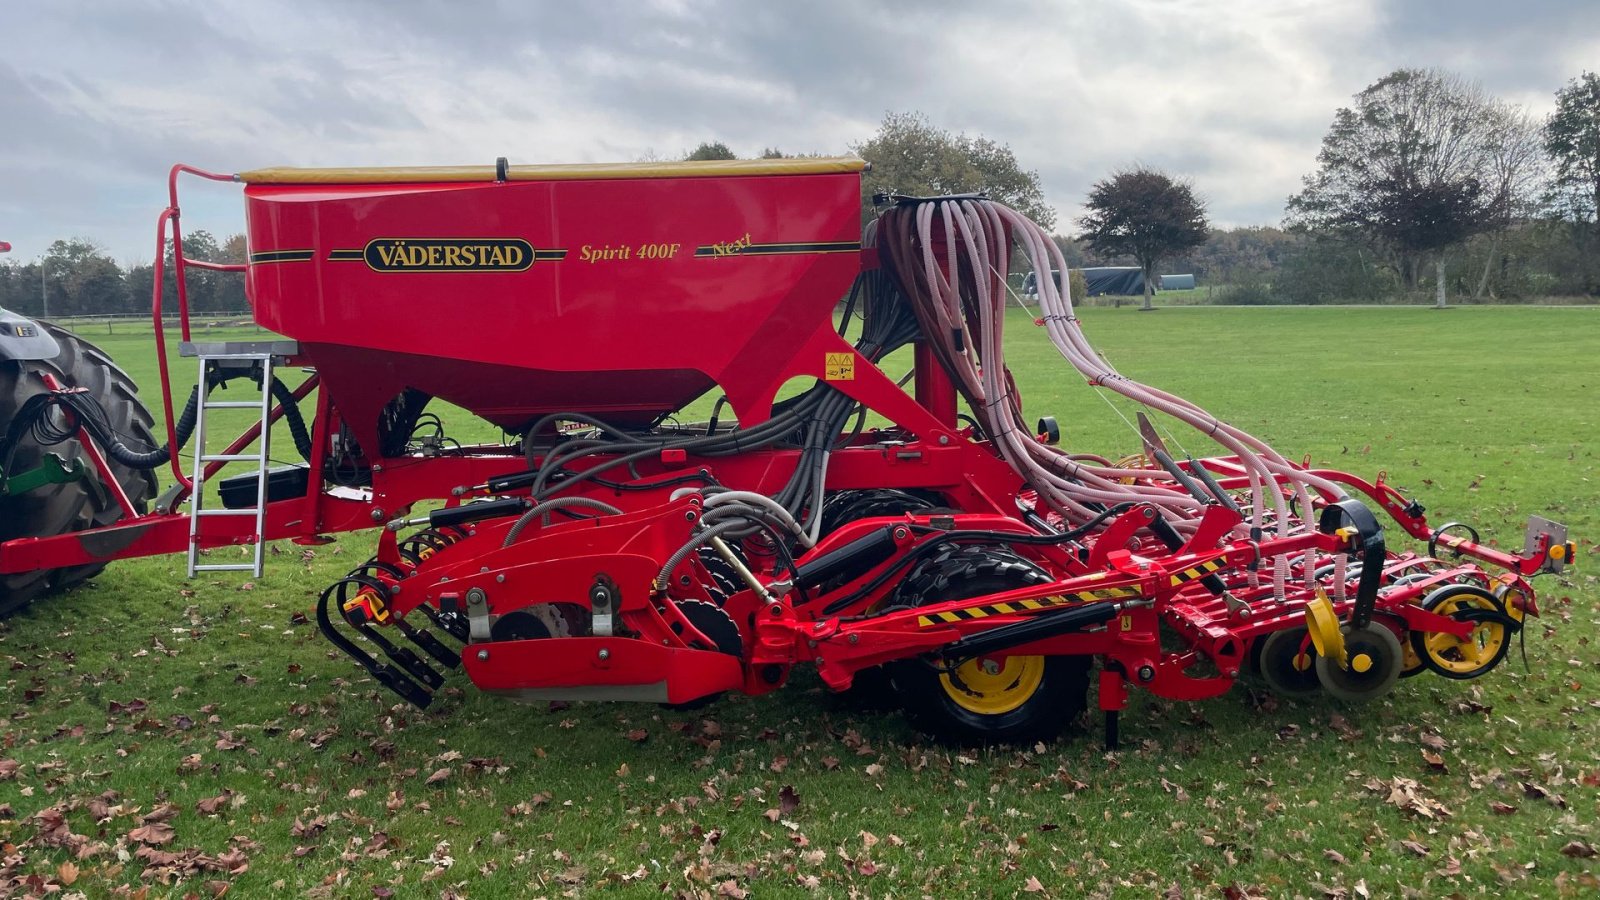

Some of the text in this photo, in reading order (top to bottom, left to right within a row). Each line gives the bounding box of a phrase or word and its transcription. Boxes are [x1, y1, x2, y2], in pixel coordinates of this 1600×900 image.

[376, 241, 523, 267] VÄDERSTAD
[579, 243, 681, 264] Spirit 400F
[712, 232, 752, 260] Next
